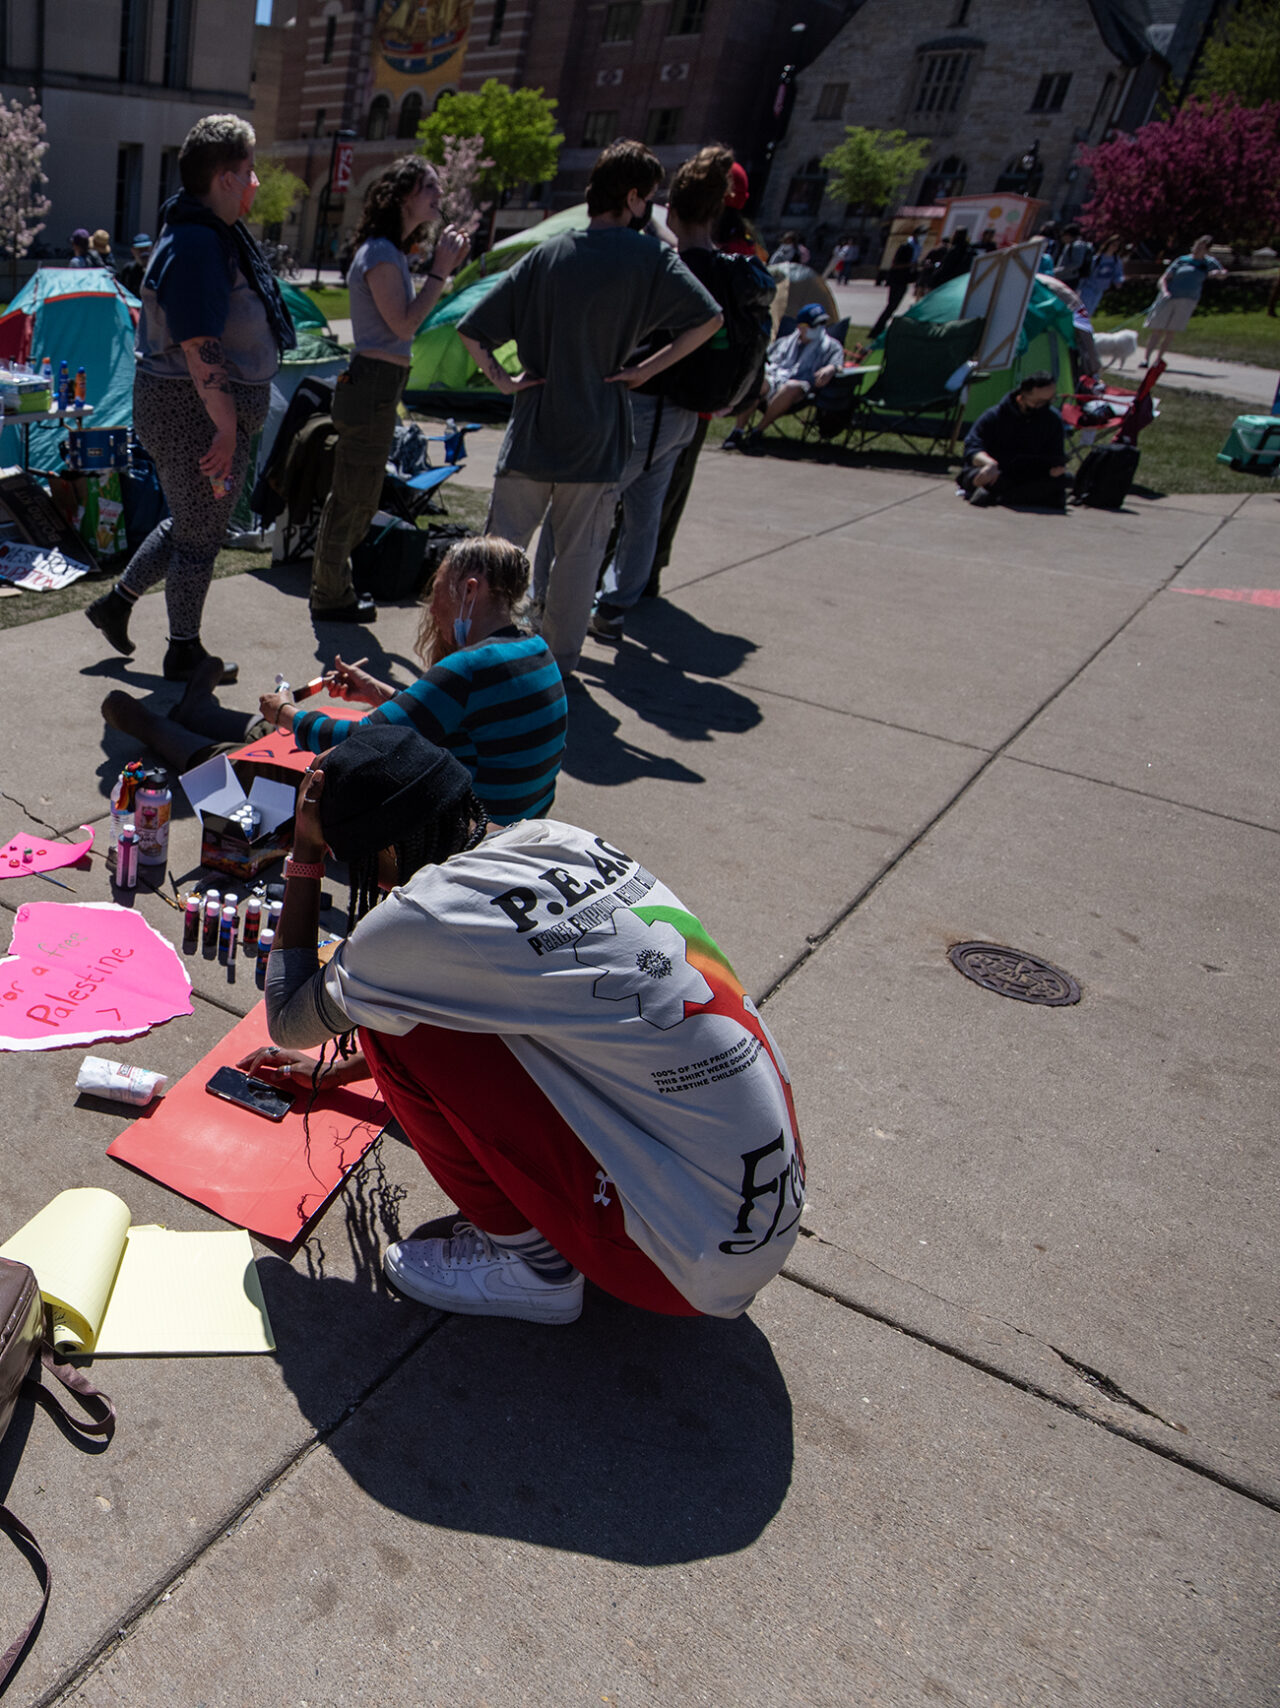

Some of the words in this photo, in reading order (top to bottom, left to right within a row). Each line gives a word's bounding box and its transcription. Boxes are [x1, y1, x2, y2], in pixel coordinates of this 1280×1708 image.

[338, 149, 352, 187] 175
[38, 932, 88, 958] free
[527, 921, 579, 957] PEACE
[26, 947, 135, 1027] Palestine
[31, 966, 49, 976] a
[650, 1069, 677, 1079] 100%
[677, 1065, 691, 1074] OF
[691, 1059, 709, 1070] THE
[709, 1046, 738, 1064] PROFITS
[654, 1075, 678, 1086] THIS
[679, 1069, 706, 1082] SHIRT
[706, 1061, 730, 1075] WERE
[730, 1046, 752, 1066] DONATED
[658, 1079, 710, 1094] PALESTINE
[711, 1061, 751, 1083] CHILDREN'S
